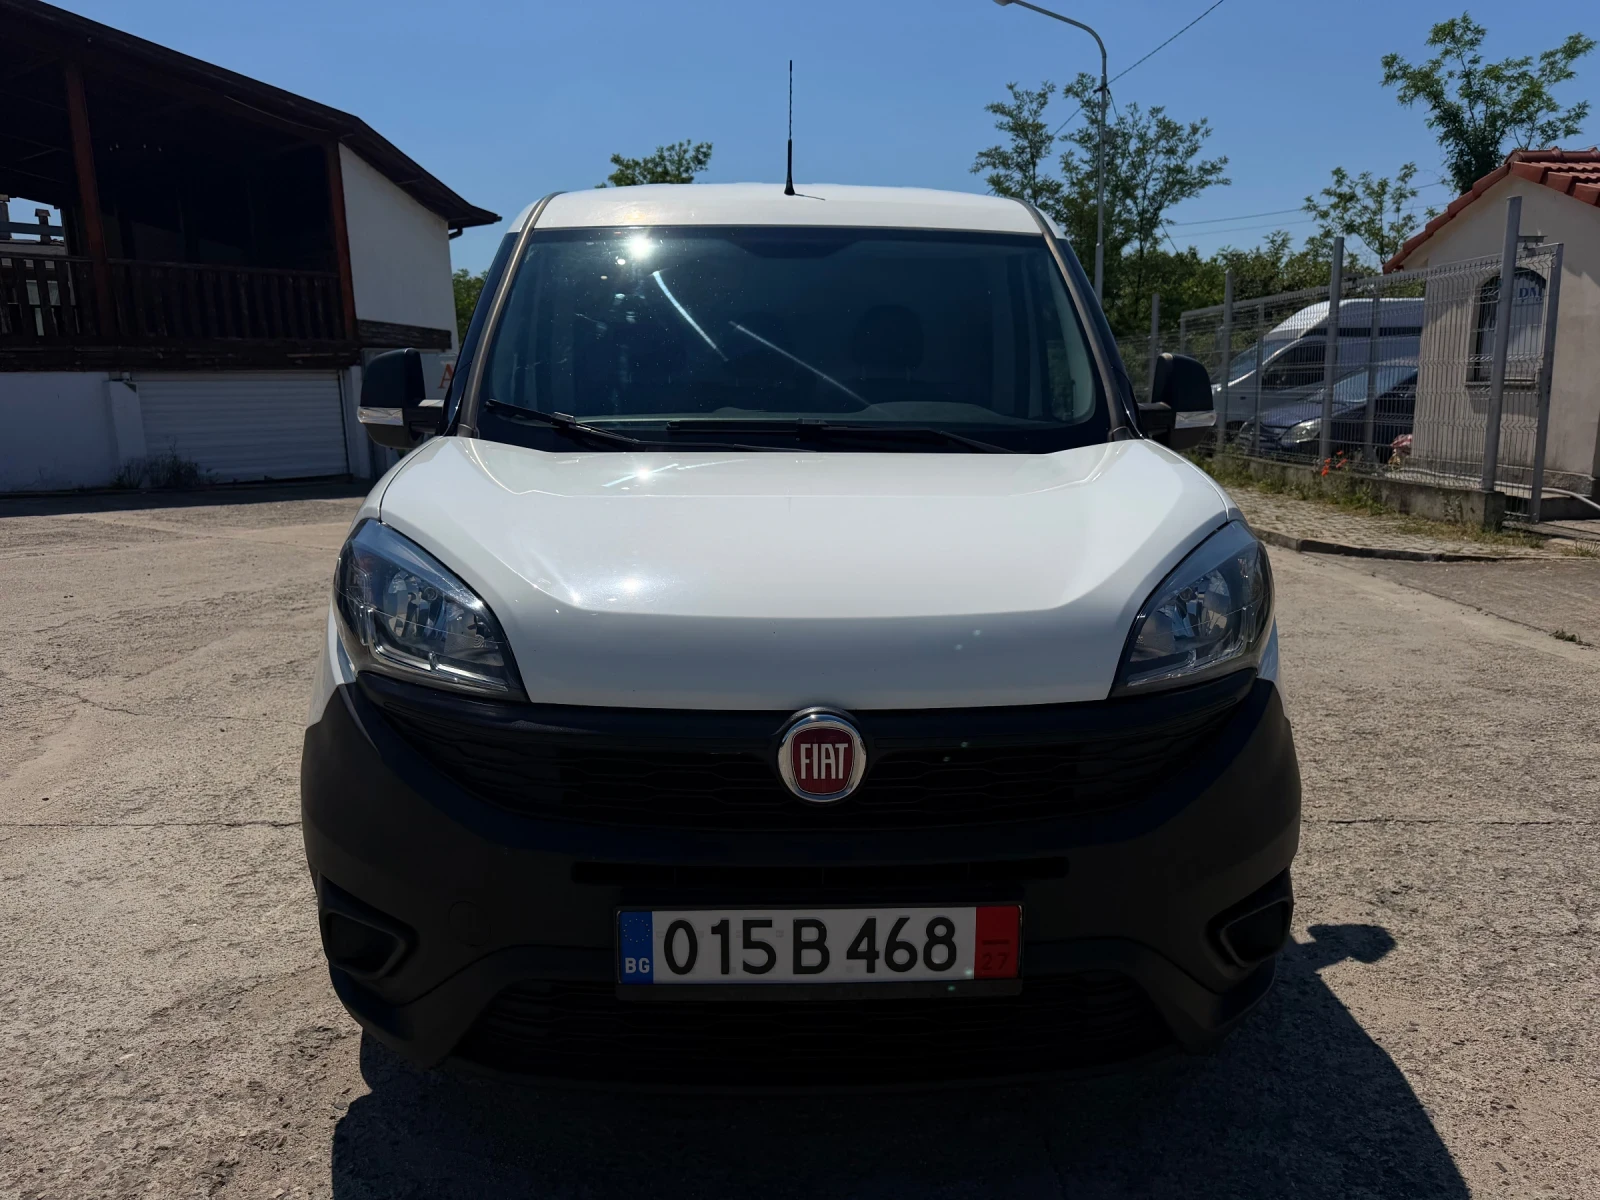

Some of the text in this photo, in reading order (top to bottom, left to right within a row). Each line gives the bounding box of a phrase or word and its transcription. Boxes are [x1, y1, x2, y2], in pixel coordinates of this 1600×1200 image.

[800, 743, 849, 780] FIAT
[624, 957, 650, 974] BG
[980, 952, 1010, 971] 27
